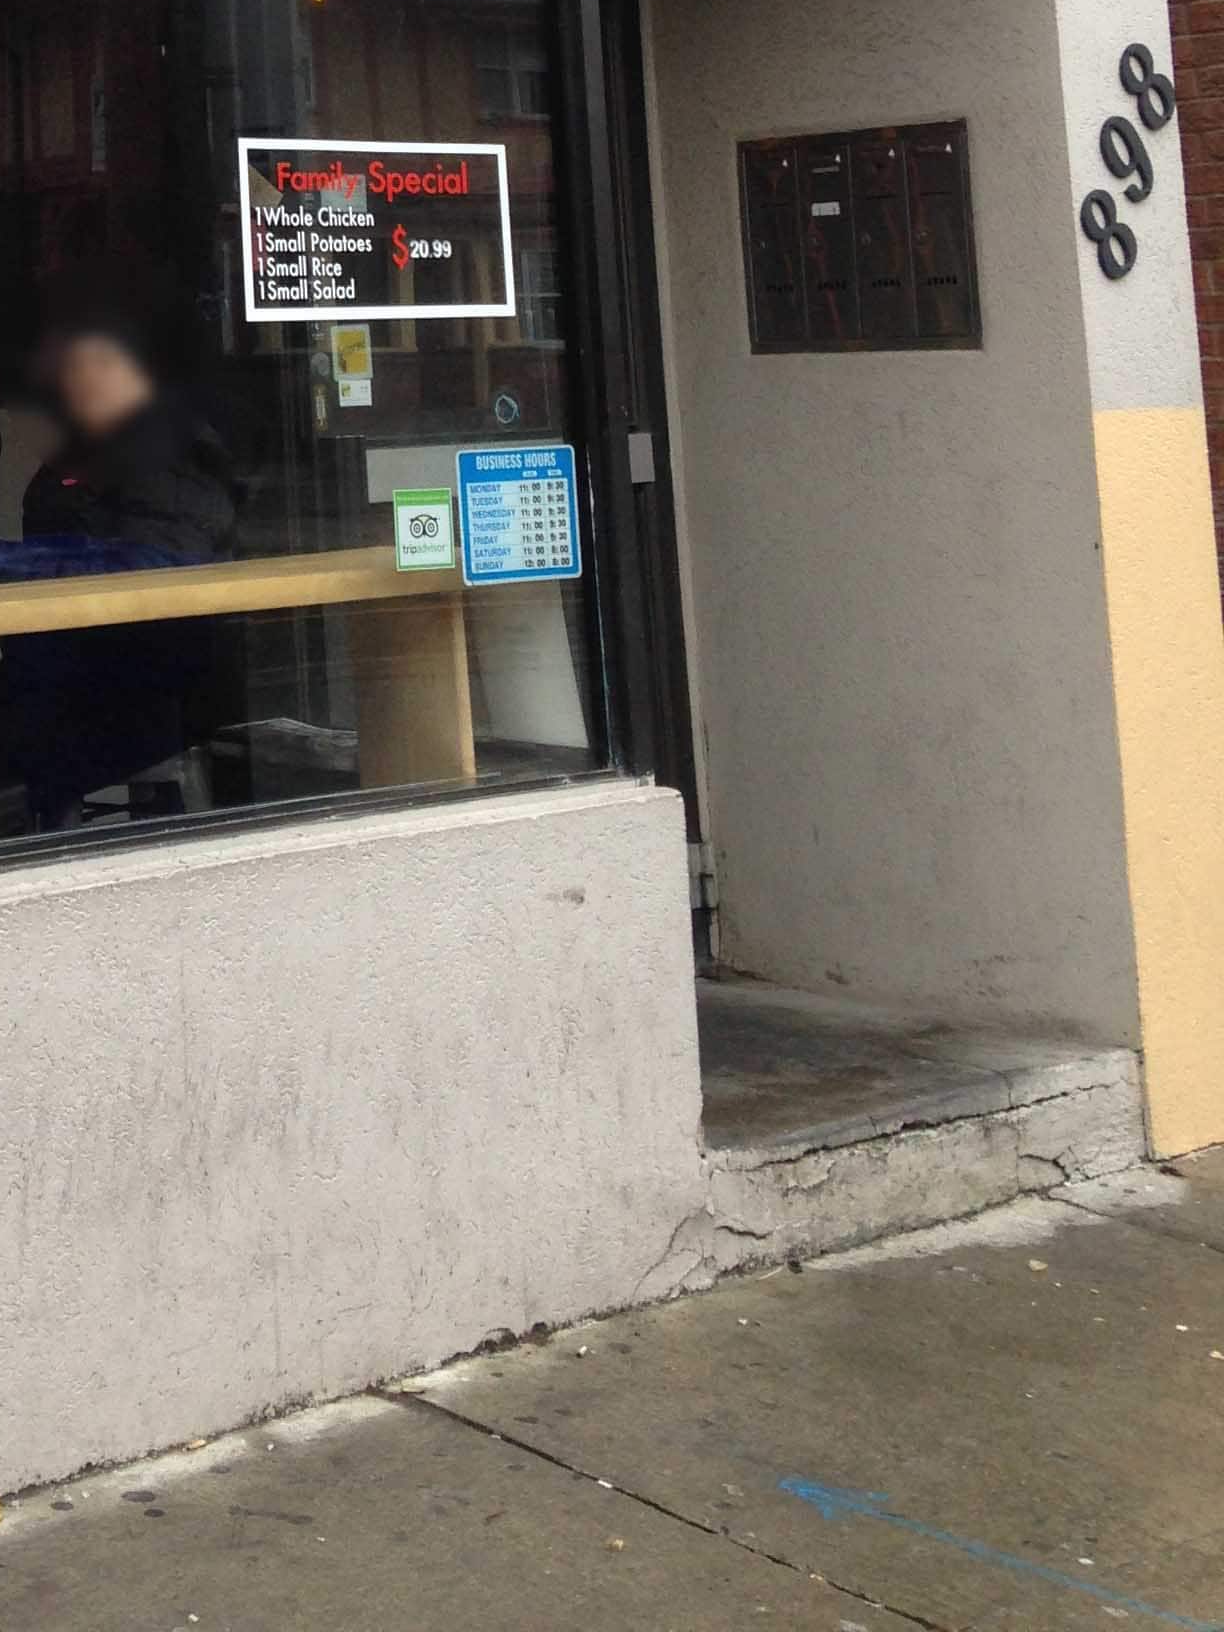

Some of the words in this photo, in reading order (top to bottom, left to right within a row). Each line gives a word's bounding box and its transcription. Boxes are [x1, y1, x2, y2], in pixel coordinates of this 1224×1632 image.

[1081, 43, 1174, 279] 898
[276, 160, 360, 200] Family
[368, 160, 469, 203] Special
[317, 206, 375, 227] Chicken
[310, 232, 373, 253] Potatoes
[311, 256, 343, 277] Rice
[312, 278, 356, 300] Salad
[476, 453, 522, 470] BUSINESS
[523, 451, 556, 468] HOURS
